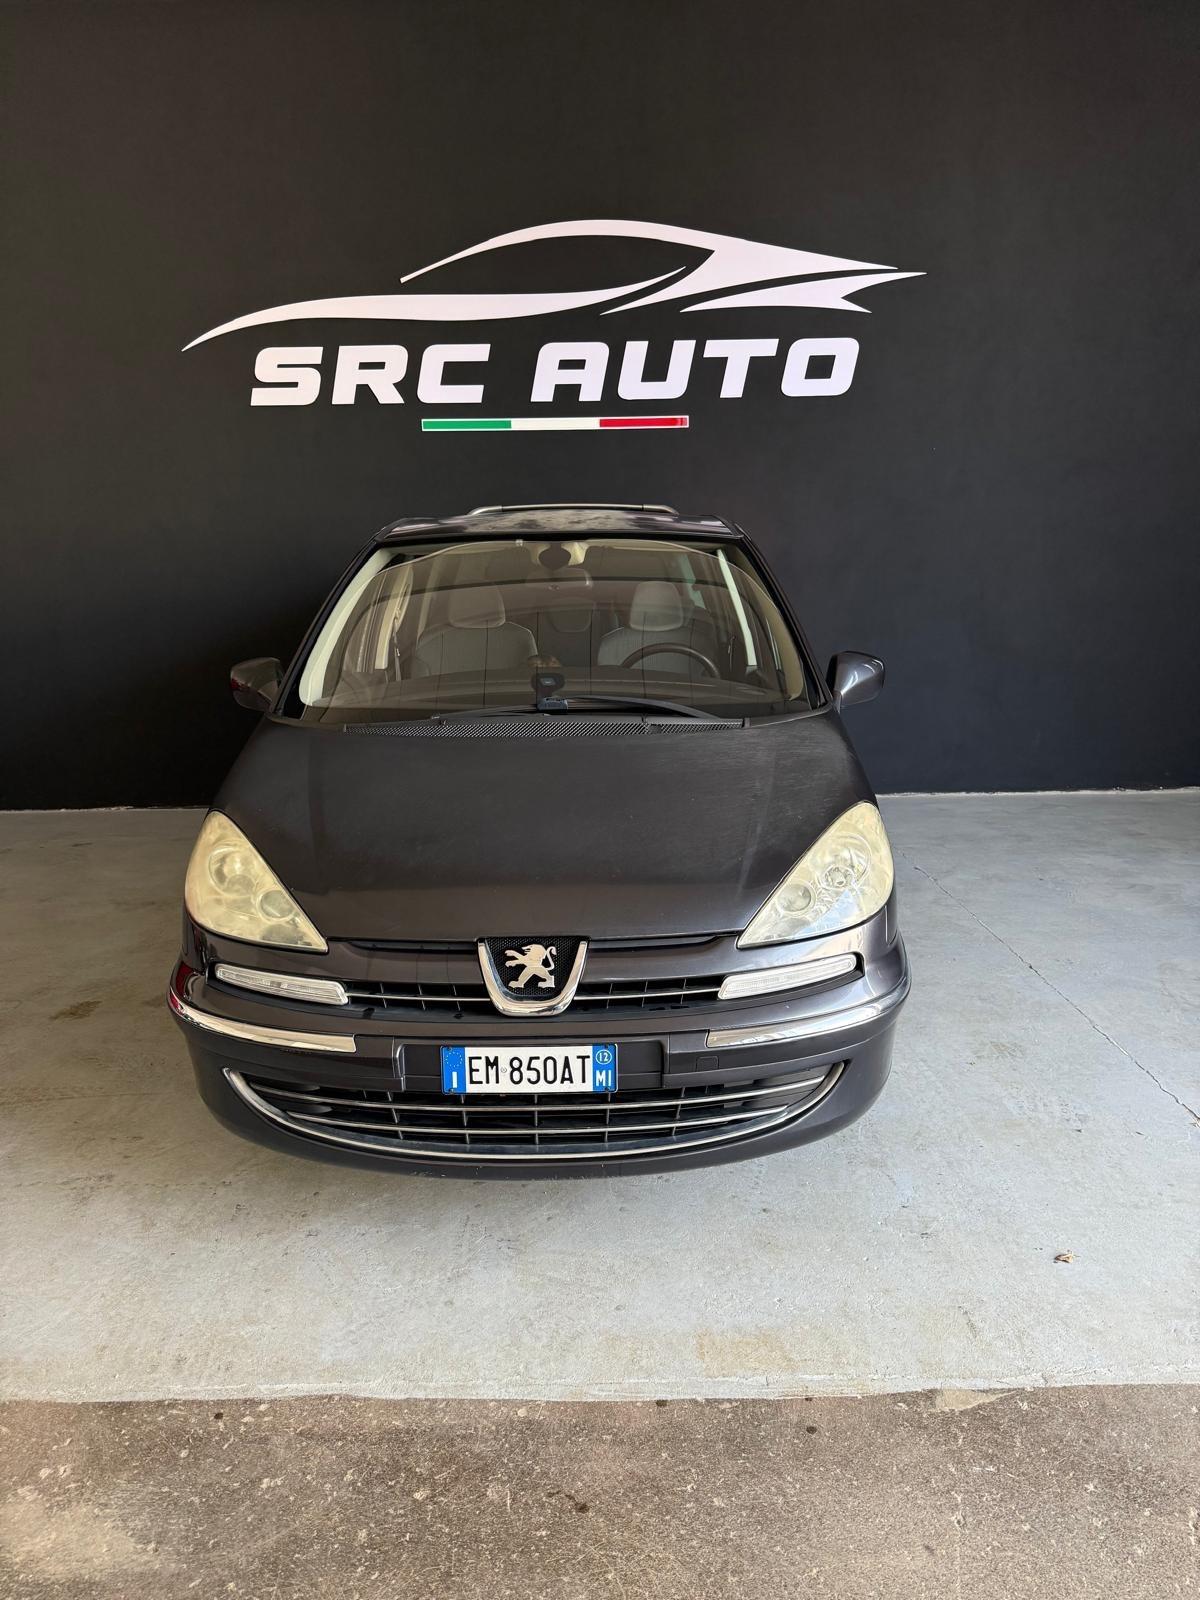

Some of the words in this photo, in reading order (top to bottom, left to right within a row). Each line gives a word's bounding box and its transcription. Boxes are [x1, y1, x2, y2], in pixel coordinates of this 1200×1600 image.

[250, 343, 491, 406] SRC
[530, 337, 860, 402] AUTO
[452, 1071, 458, 1089] I
[468, 1055, 500, 1085] EM
[509, 1054, 591, 1085] 850AT
[595, 1069, 612, 1087] MI
